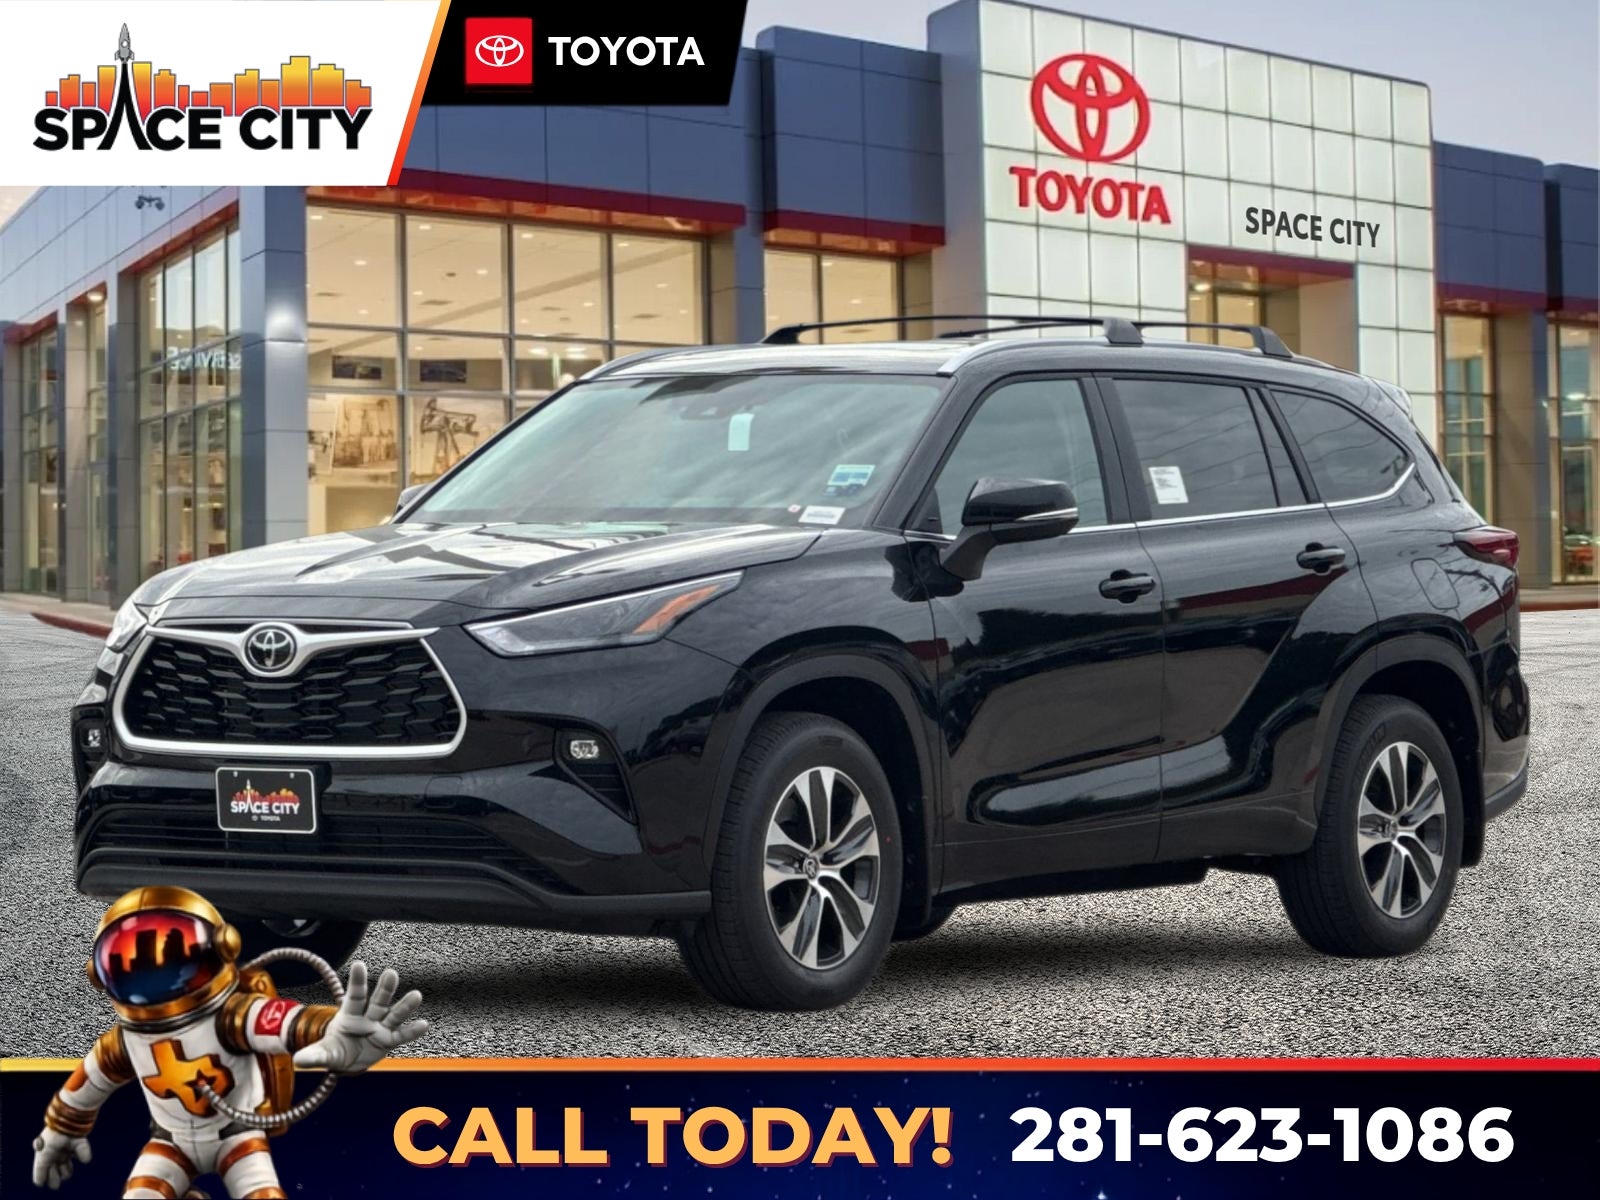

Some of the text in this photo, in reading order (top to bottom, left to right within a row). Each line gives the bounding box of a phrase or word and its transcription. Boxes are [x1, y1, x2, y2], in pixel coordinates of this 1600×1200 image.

[1009, 166, 1171, 224] TOYOTA
[1245, 206, 1381, 248] SPACE CITY
[230, 799, 300, 815] SPACE CITY
